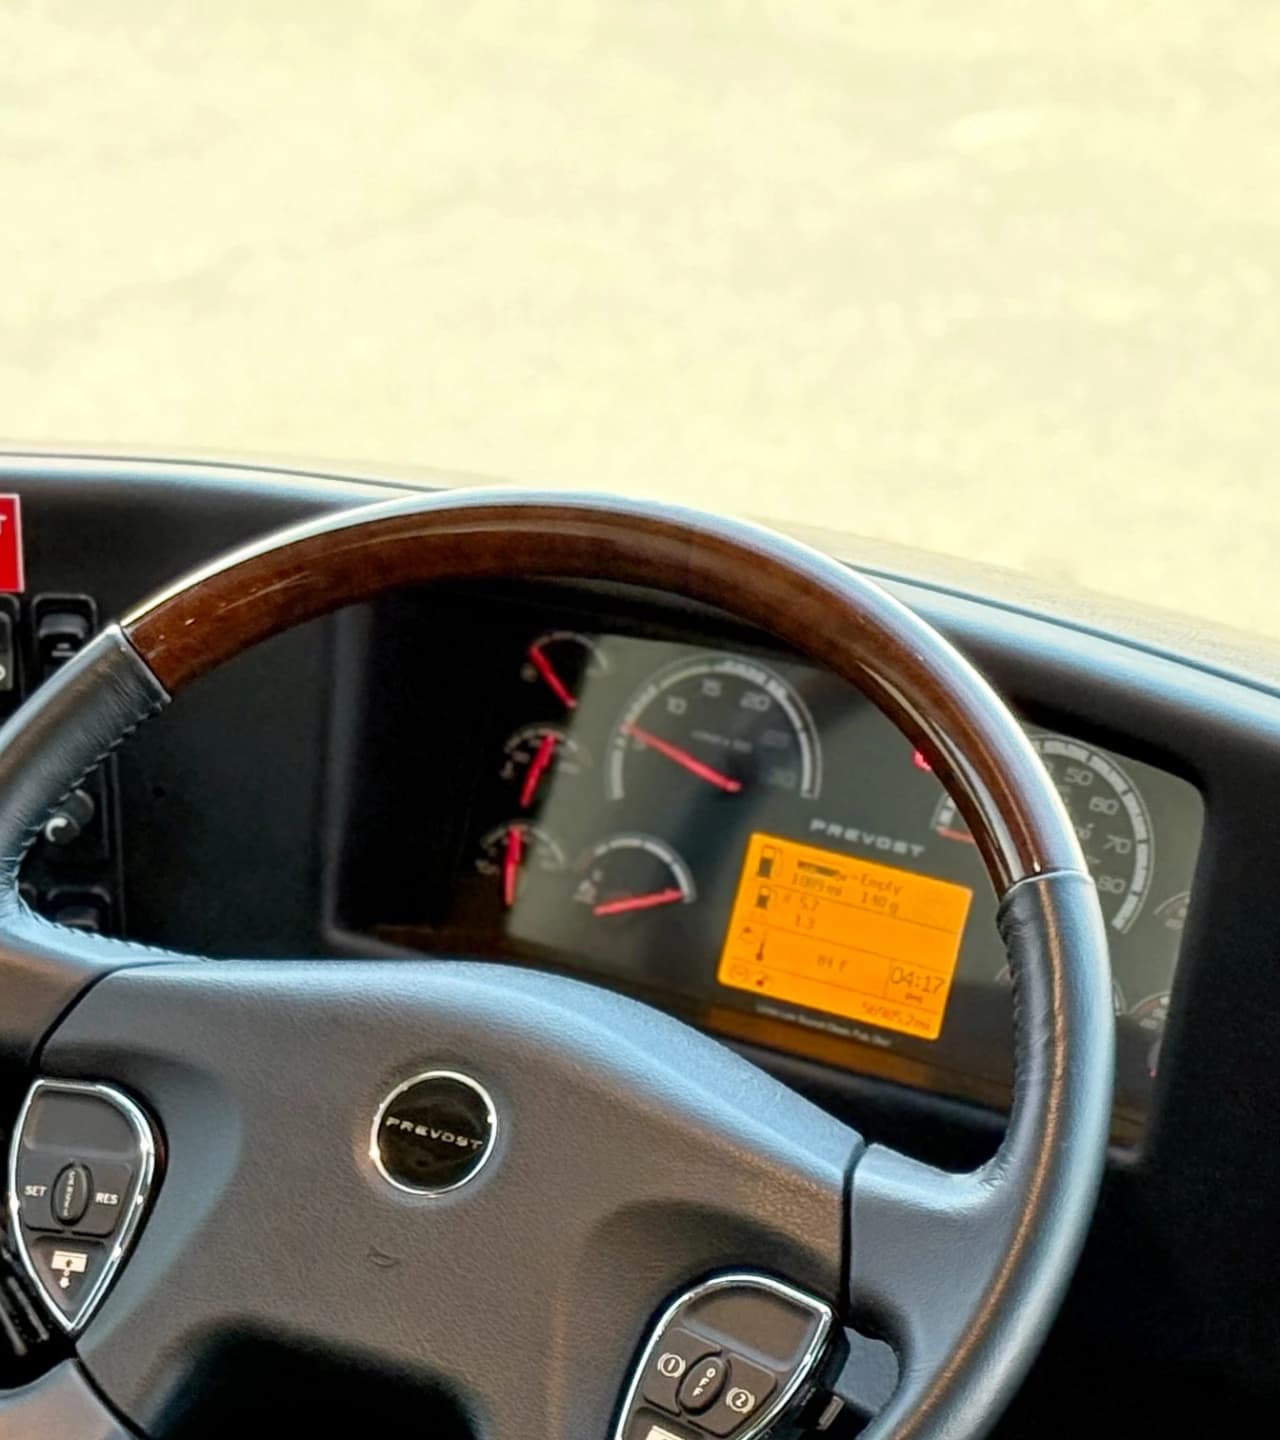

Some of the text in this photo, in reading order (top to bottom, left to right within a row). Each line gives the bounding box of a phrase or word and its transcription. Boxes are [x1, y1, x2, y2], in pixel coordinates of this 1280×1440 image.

[740, 691, 770, 713] 20
[1063, 766, 1095, 787] 50
[1088, 795, 1120, 816] 60
[809, 817, 926, 858] PREVOST
[1103, 834, 1132, 855] 70
[891, 966, 946, 995] 04:17
[384, 1116, 484, 1151] PREVOST
[23, 1184, 49, 1198] SET
[94, 1191, 120, 1206] RES
[692, 1367, 717, 1398] OFF
